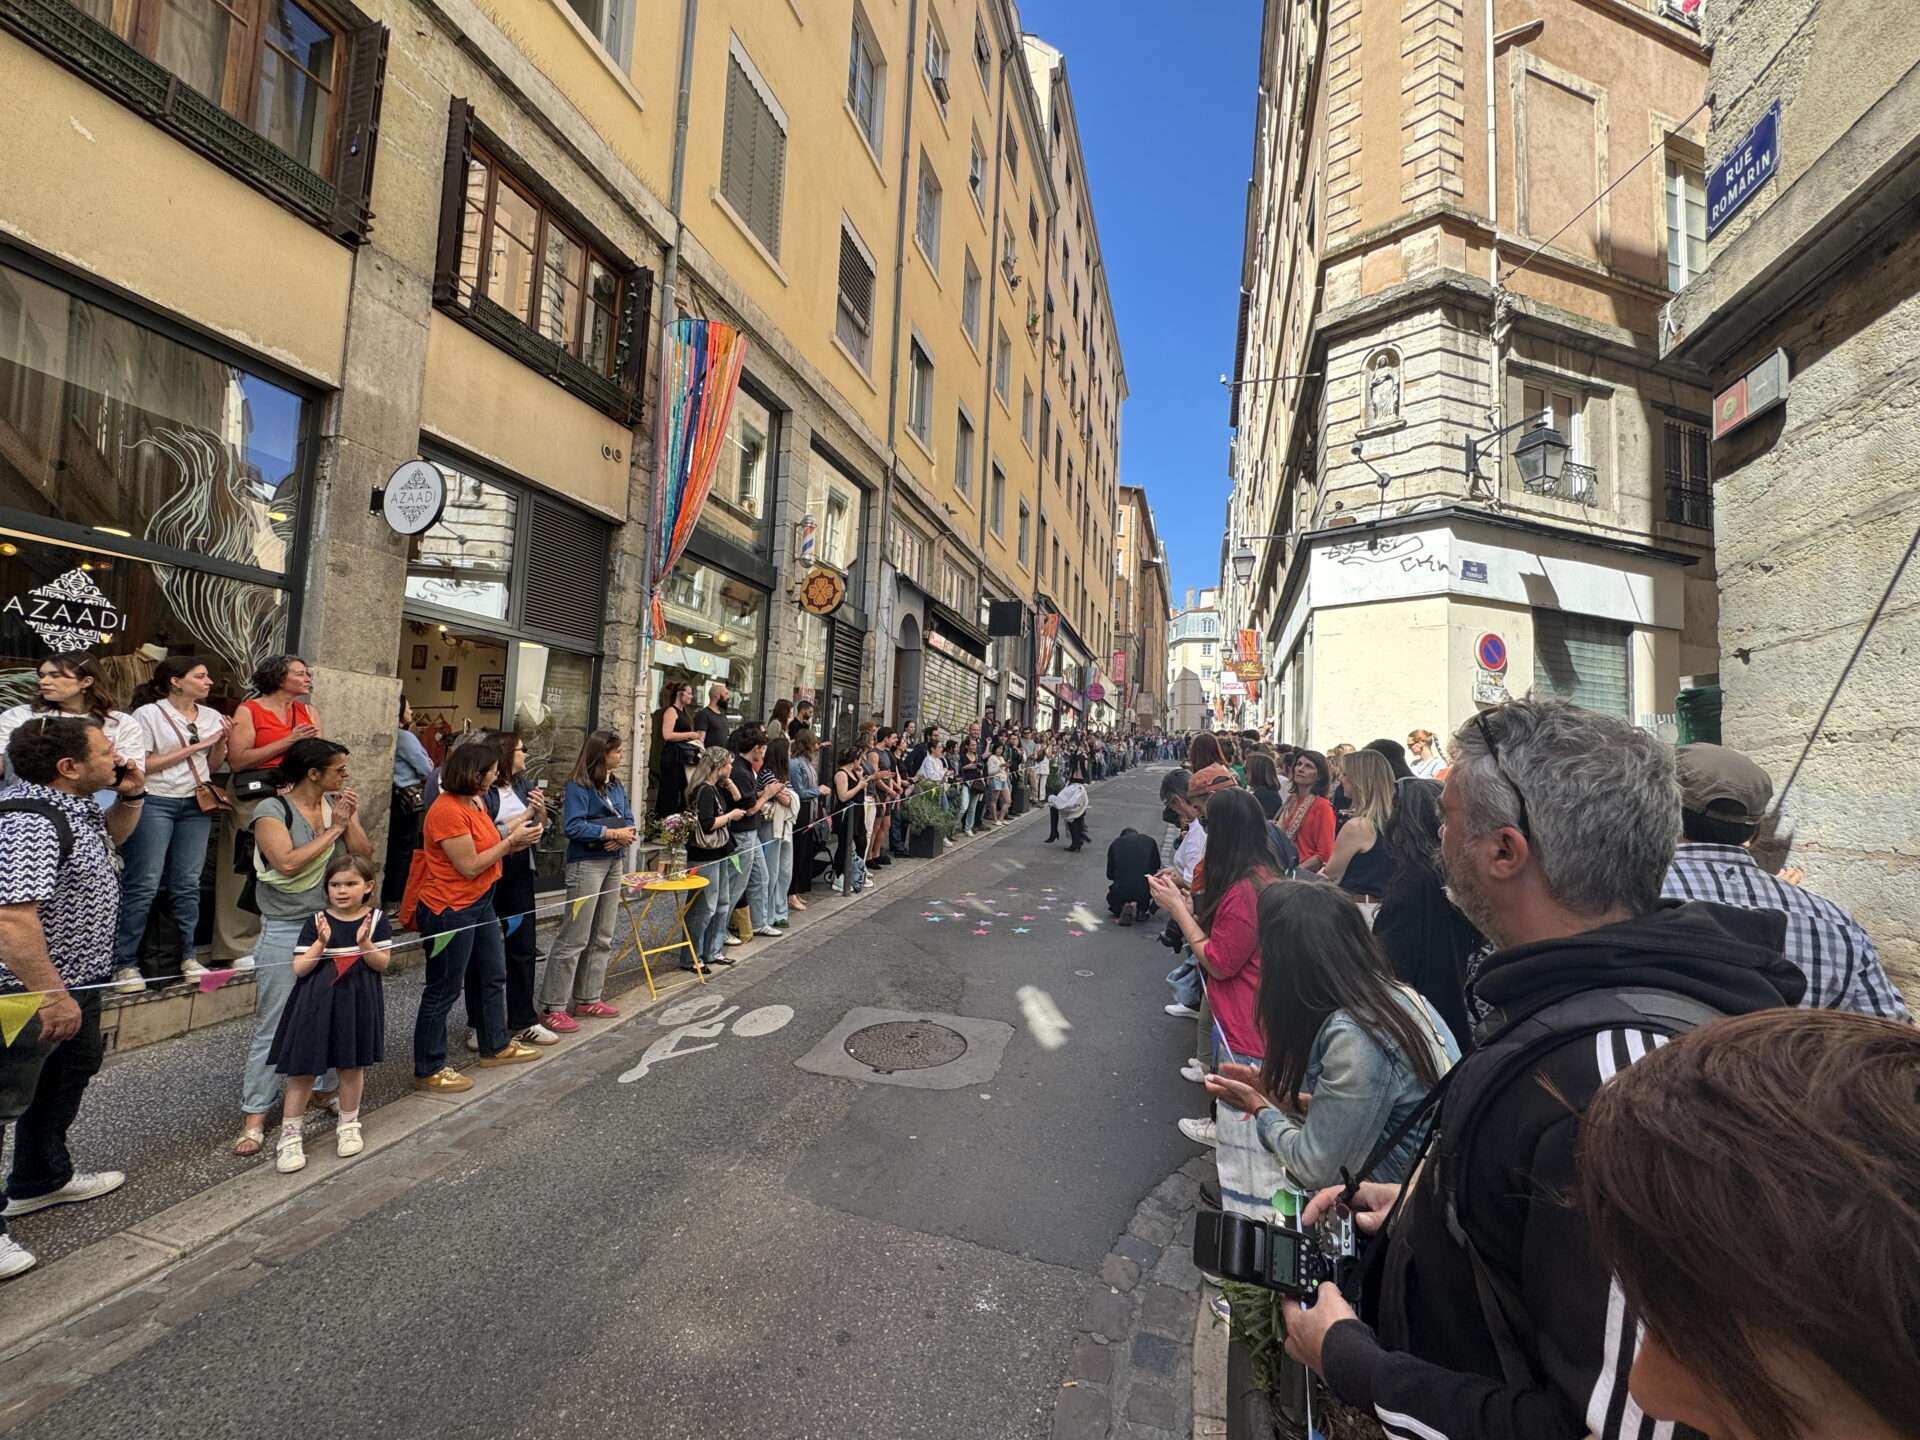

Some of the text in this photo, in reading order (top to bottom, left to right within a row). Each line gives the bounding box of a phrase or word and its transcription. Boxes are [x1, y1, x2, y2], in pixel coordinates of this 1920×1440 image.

[1725, 145, 1753, 186] RUE
[1712, 150, 1771, 222] ROMARIN
[390, 490, 437, 505] AZAADI
[3, 595, 127, 632] AZAADI
